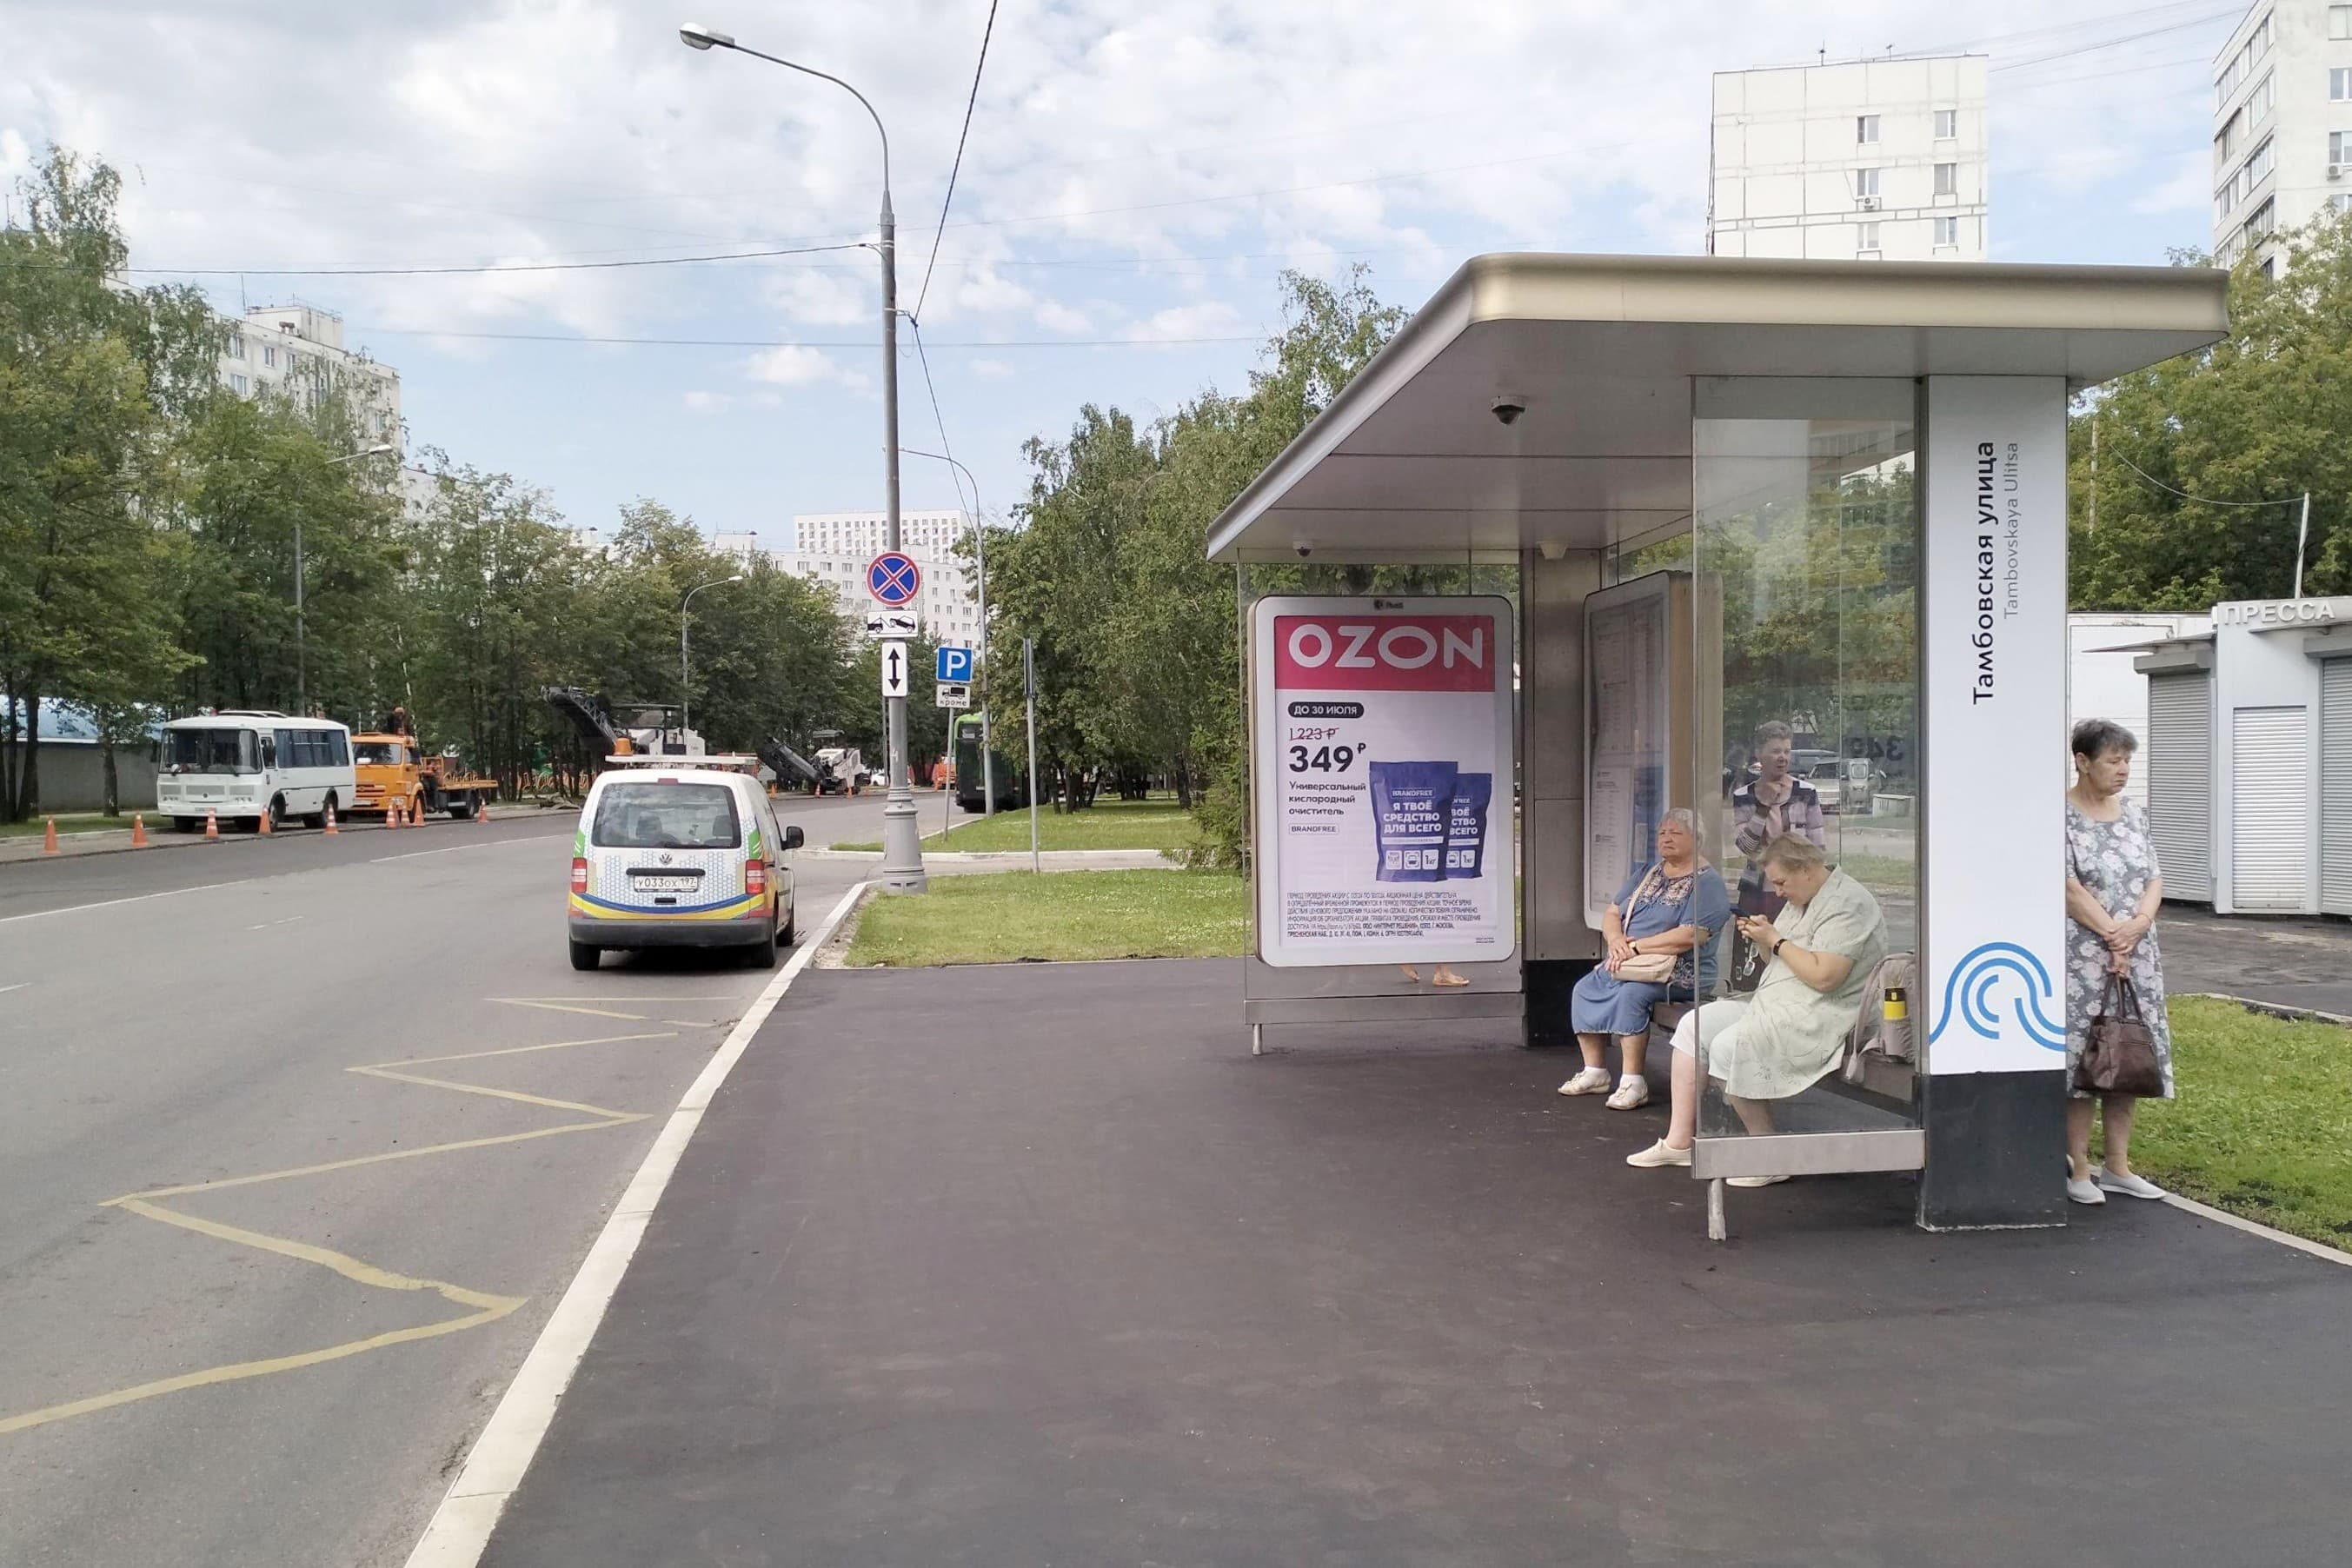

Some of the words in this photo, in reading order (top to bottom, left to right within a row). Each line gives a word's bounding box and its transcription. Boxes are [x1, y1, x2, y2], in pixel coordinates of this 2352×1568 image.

[2003, 442, 2018, 492] Ulitsa
[1978, 442, 1999, 525] улица
[2003, 498, 2022, 619] Tambovskaya
[1971, 535, 1994, 705] Тамбовская
[2224, 601, 2335, 626] ПРЕССА
[1288, 623, 1483, 669] OZON
[1293, 705, 1310, 715] ДО
[1312, 705, 1324, 714] 30
[1326, 705, 1358, 714] ИЮЛЯ
[1289, 745, 1353, 773] 349
[1288, 781, 1366, 792] Универсальный
[1288, 795, 1355, 805] кислородный
[1392, 802, 1400, 811] Я
[1403, 800, 1432, 811] ТВОЁ
[1383, 813, 1440, 824] СРЕДСТВО
[1384, 824, 1406, 834] ДЛЯ
[1409, 822, 1442, 833] ВСЕГО
[1449, 827, 1478, 835] ВСЕГО
